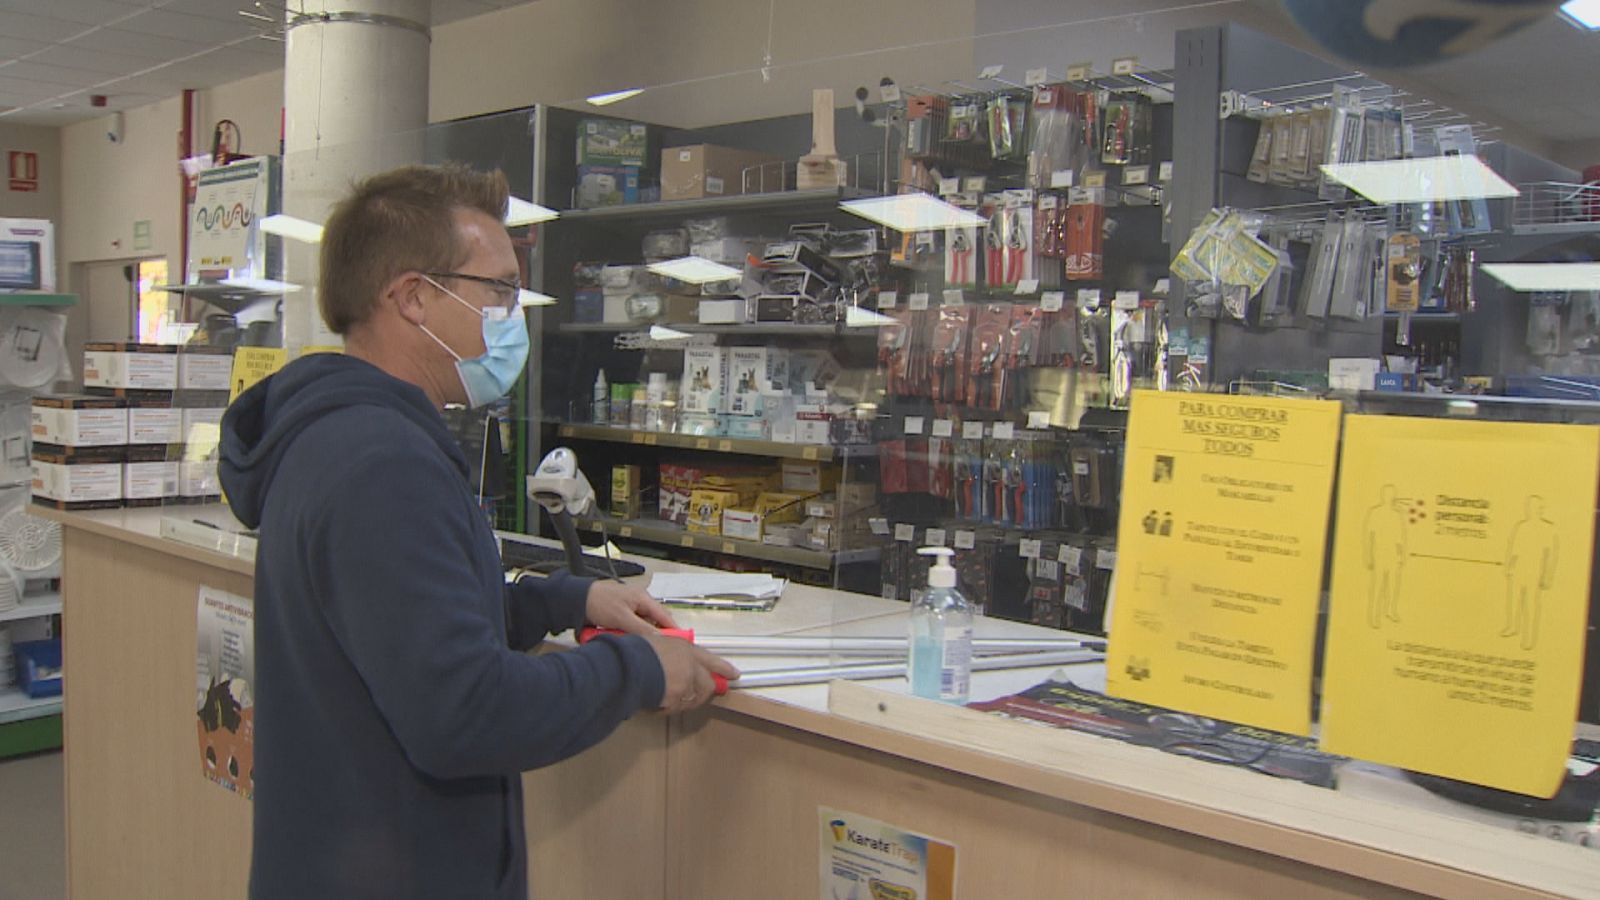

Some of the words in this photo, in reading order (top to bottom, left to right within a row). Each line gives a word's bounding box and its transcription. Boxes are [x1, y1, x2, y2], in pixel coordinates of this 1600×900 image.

[1179, 401, 1214, 416] PARA
[1216, 404, 1288, 423] COMPRAR
[1183, 419, 1213, 434] MAS
[1215, 422, 1280, 440] SEGUROS
[1203, 439, 1254, 456] TODOS
